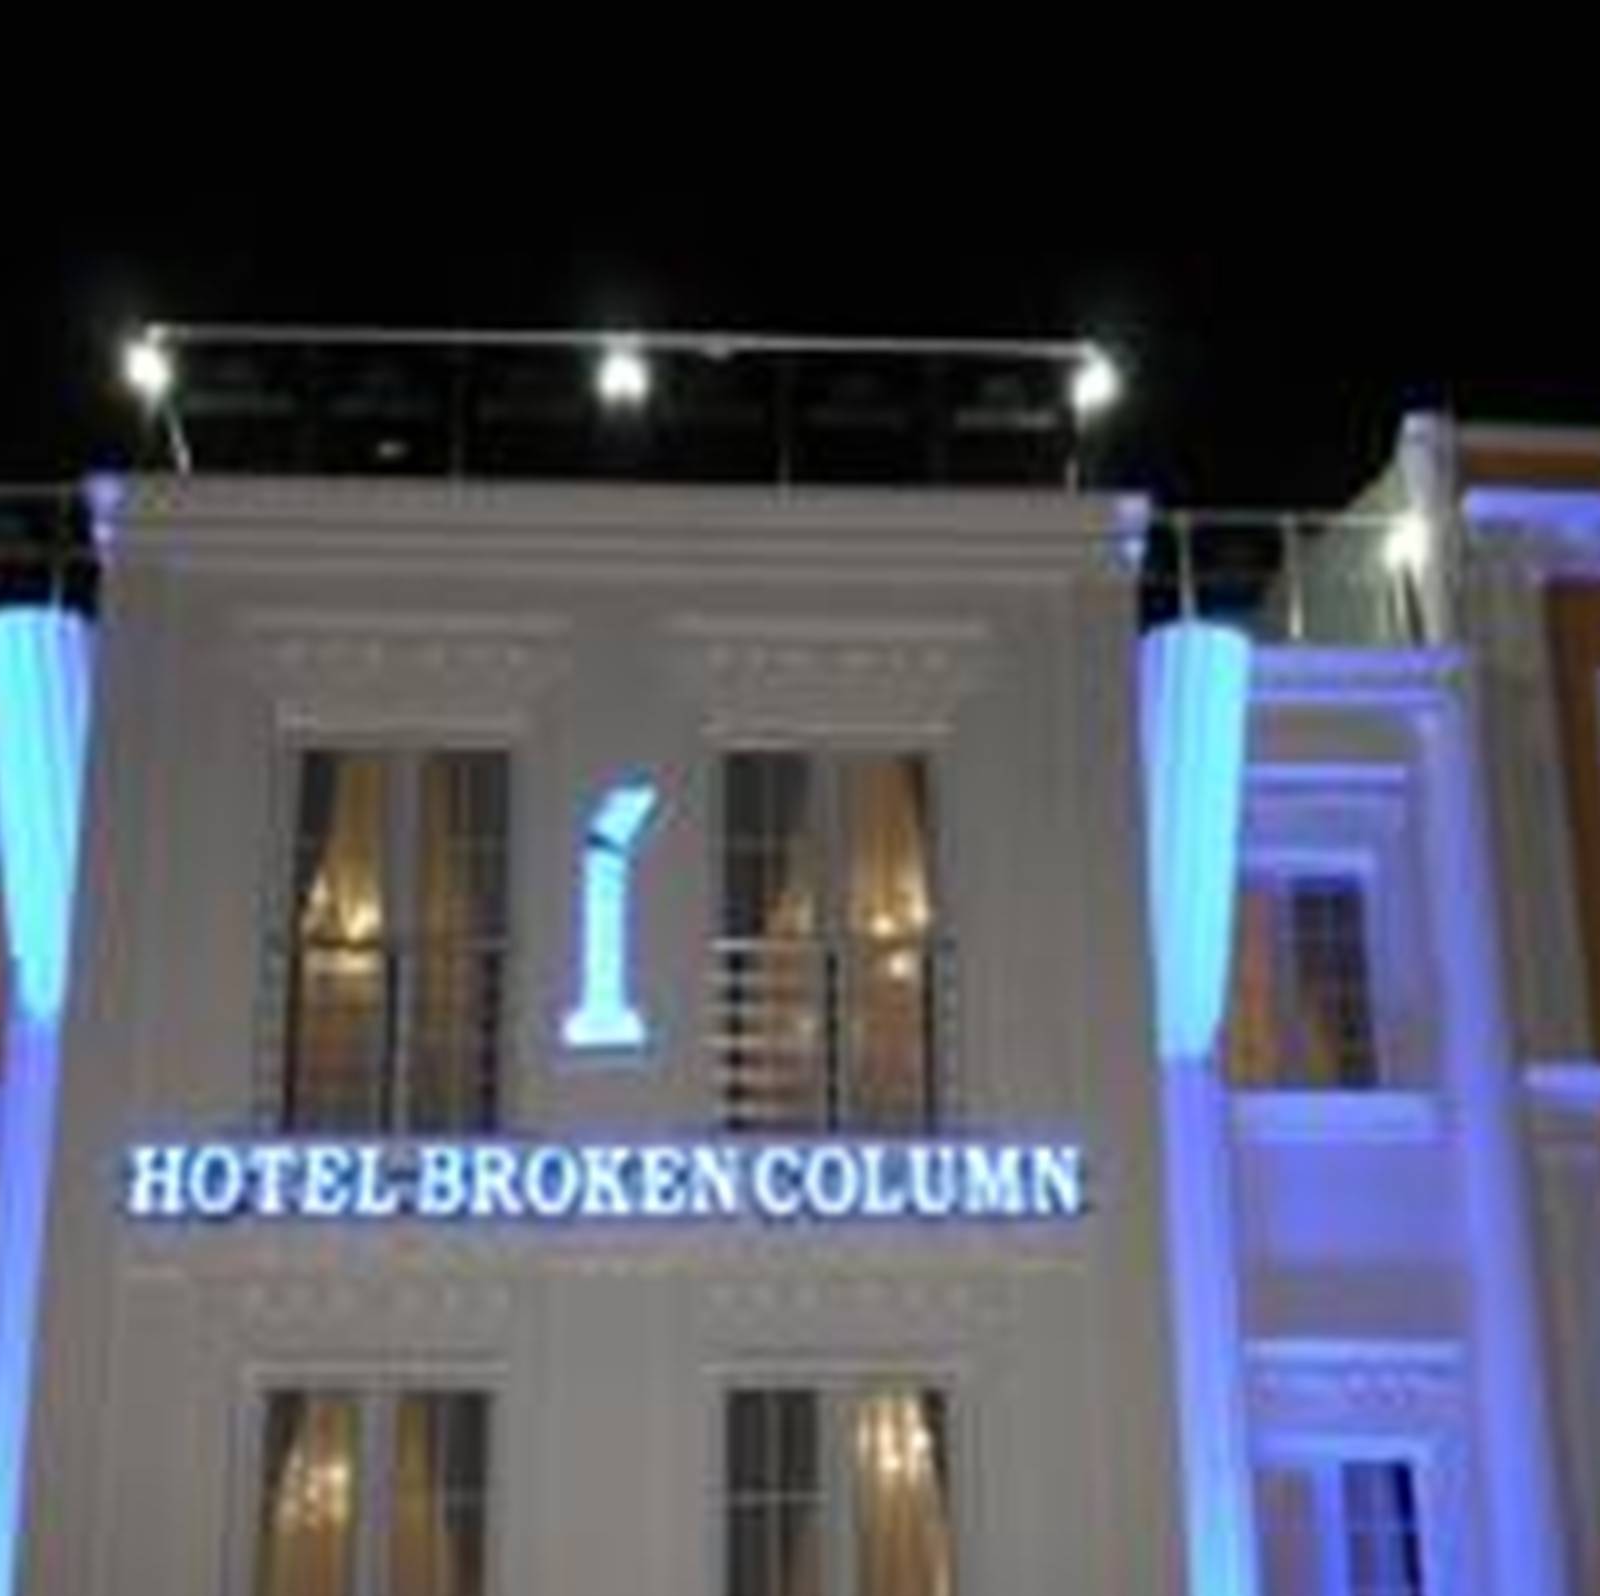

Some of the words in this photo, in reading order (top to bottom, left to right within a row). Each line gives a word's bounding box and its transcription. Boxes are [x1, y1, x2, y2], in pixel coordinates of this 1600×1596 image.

[129, 1144, 398, 1215] HOTEL
[417, 1144, 739, 1215] BROKEN
[752, 1144, 1082, 1215] COLUMN
